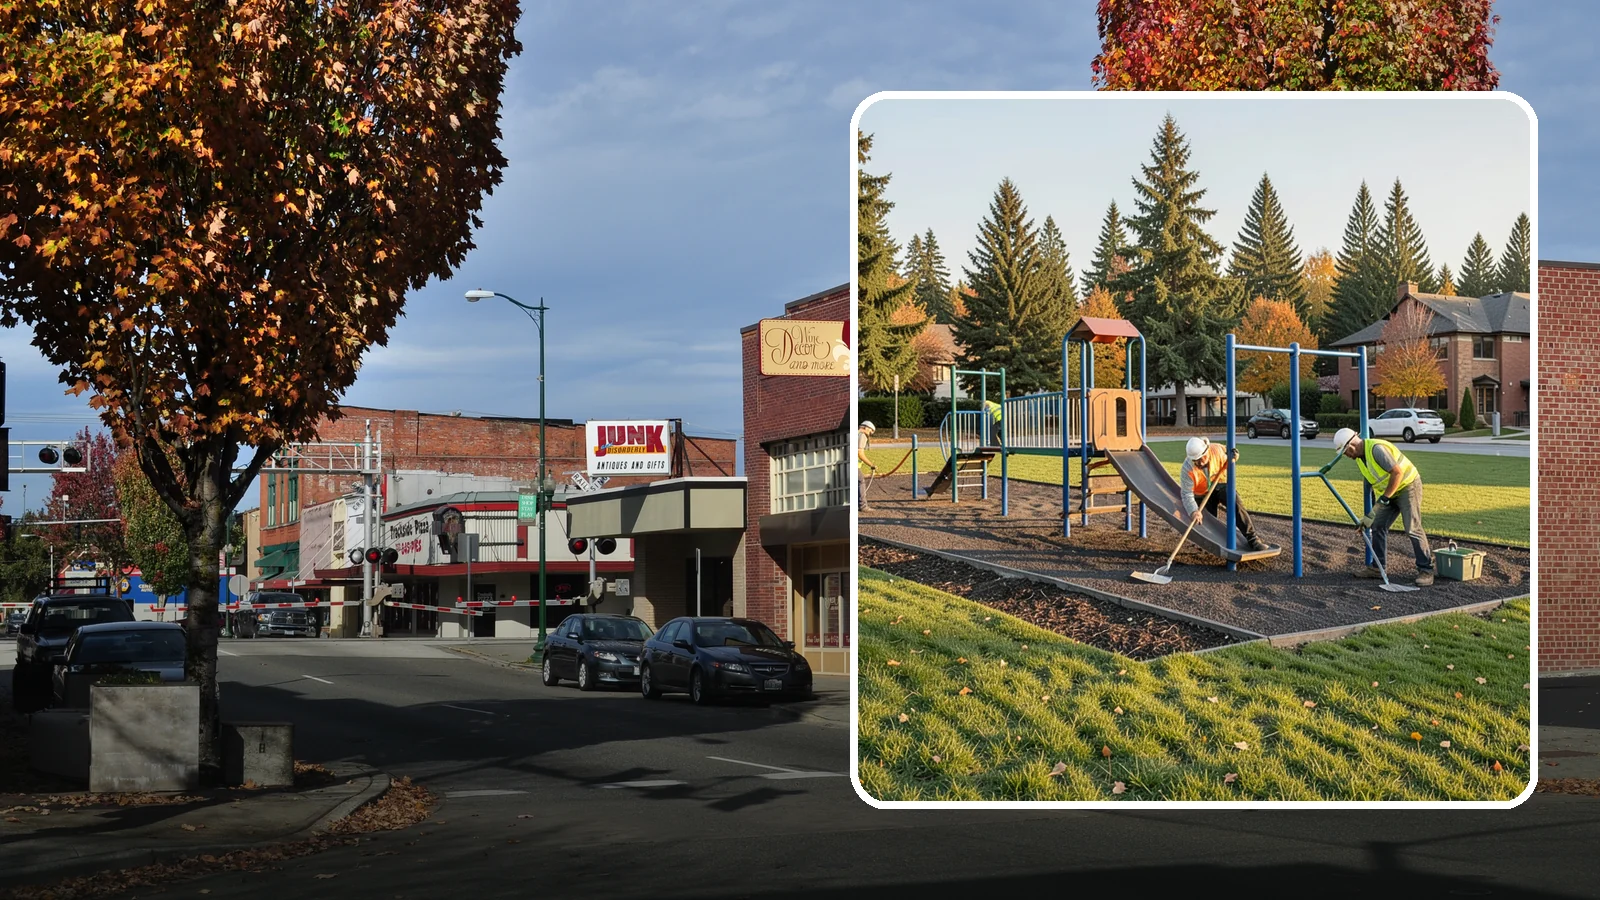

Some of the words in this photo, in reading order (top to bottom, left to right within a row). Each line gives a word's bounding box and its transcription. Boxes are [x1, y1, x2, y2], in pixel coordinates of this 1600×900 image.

[596, 425, 664, 457] JUNK
[607, 447, 646, 455] DISORDERLY
[596, 461, 628, 470] ANTIQUES
[631, 461, 644, 470] AND
[647, 460, 665, 470] GIFTS
[390, 522, 412, 539] Trackside
[414, 519, 429, 535] Pizza
